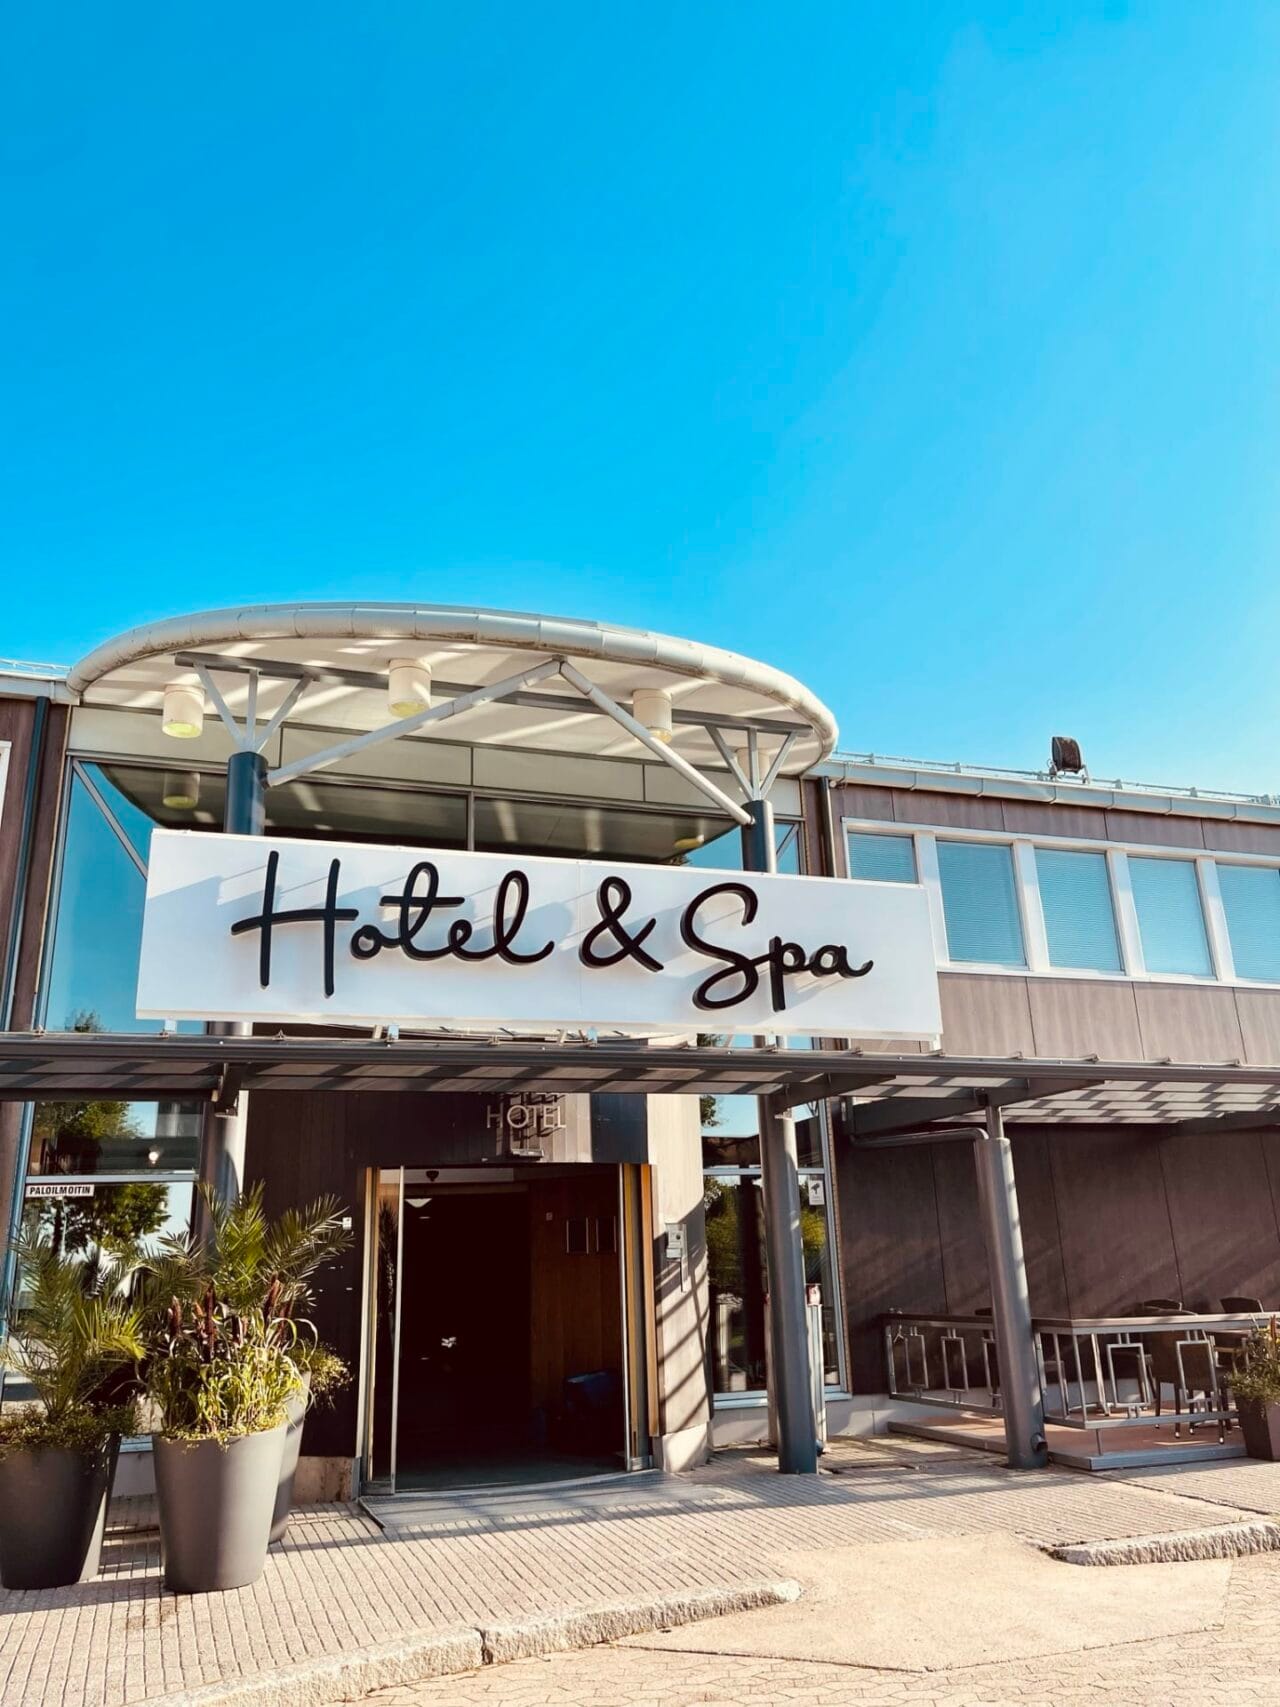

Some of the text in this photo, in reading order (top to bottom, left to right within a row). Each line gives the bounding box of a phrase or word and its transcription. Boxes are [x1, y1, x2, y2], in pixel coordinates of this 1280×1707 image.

[231, 850, 874, 1012] Hotel & Spa
[486, 1103, 567, 1129] HOTEL
[29, 1186, 91, 1195] PALOILMOITIN
